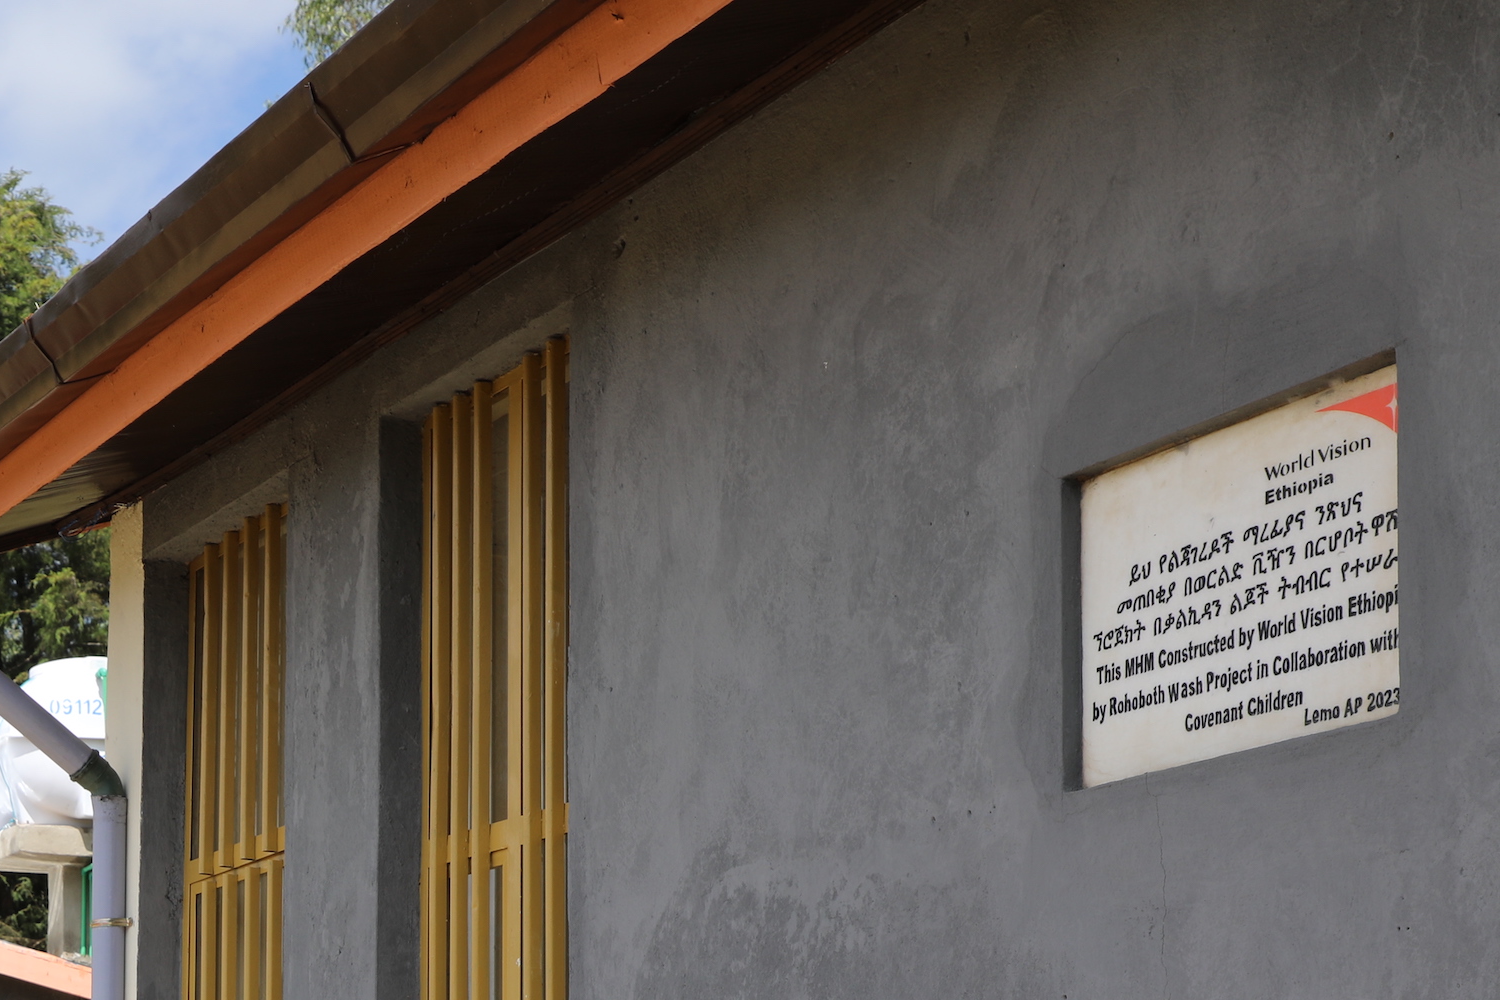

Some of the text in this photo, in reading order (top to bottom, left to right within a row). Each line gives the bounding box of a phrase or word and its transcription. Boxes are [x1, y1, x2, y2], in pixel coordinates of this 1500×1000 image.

[1264, 436, 1371, 480] World Vision
[1265, 473, 1334, 505] Ethiopia
[1129, 562, 1151, 586] ይህ
[1159, 531, 1234, 574] የልጃገረዶች
[1243, 510, 1306, 545] ማረፊያና
[1117, 582, 1176, 614] መጠበቂያ
[1184, 562, 1244, 597] በወርልድ
[1252, 546, 1295, 576] ቪዥን
[1230, 582, 1269, 615] ልጆች
[1278, 567, 1331, 600] ትብብር
[1096, 663, 1121, 685] This
[1124, 652, 1154, 678] MHM
[1158, 629, 1235, 669] Constructed
[1239, 627, 1255, 651] by
[1258, 612, 1296, 641] World
[1300, 605, 1343, 630] Vision
[1092, 702, 1107, 724] by
[1109, 684, 1165, 716] Rohoboth
[1168, 677, 1203, 704] Wash
[1207, 662, 1252, 692] Project
[1256, 660, 1269, 680] in
[1273, 640, 1366, 676] Collaboration
[1185, 690, 1303, 732] Covenant Children
[1304, 687, 1400, 726] Lemo AP 2023
